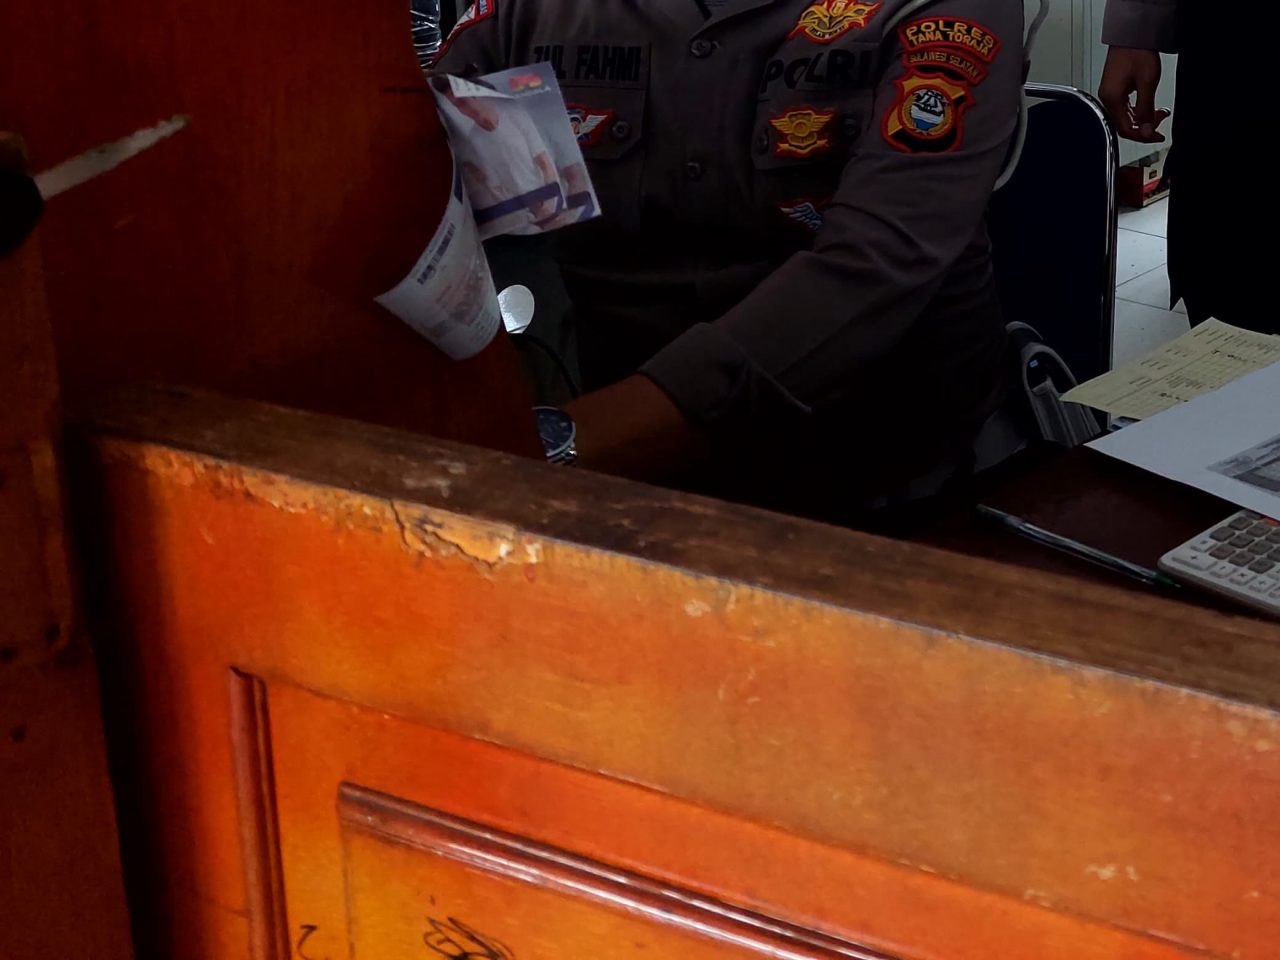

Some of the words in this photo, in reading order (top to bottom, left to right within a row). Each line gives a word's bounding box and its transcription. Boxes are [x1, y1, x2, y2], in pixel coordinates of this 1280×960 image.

[905, 20, 995, 48] POLRES
[909, 31, 944, 46] TANA
[946, 31, 990, 57] TORAJA
